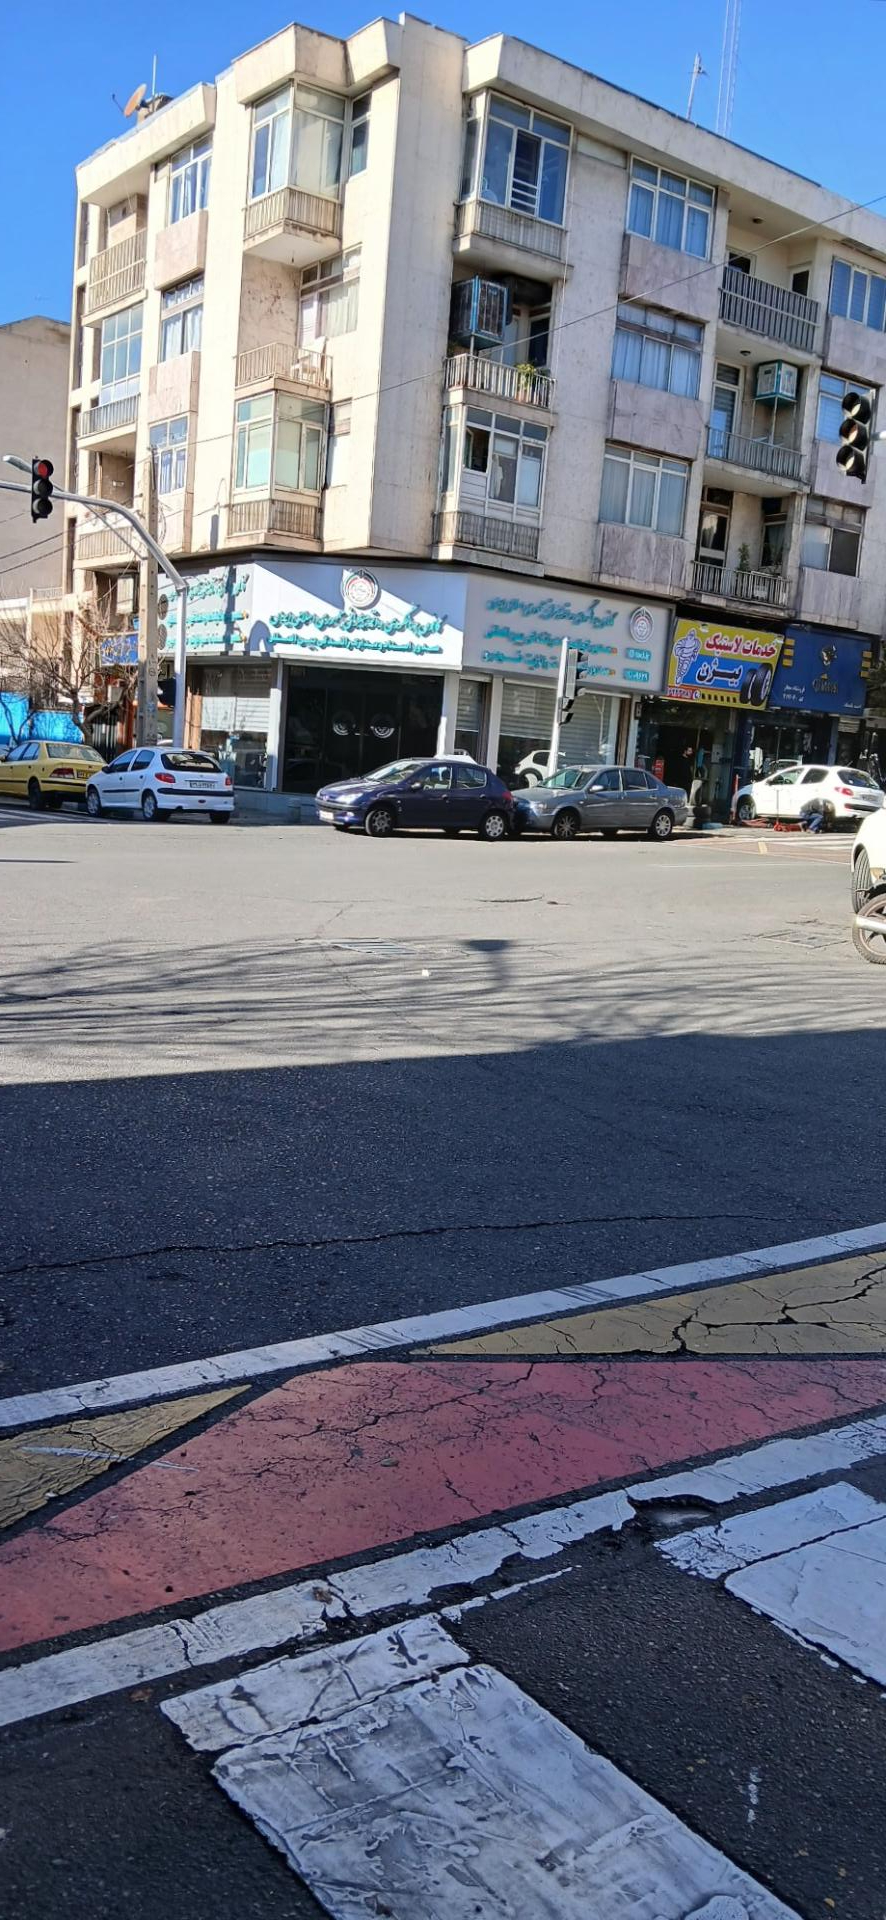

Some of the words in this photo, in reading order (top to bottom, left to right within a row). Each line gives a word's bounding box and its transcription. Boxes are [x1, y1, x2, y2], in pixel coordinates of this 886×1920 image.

[705, 632, 743, 656] لاستیک
[742, 639, 777, 658] خدمات
[697, 657, 744, 686] بیژن
